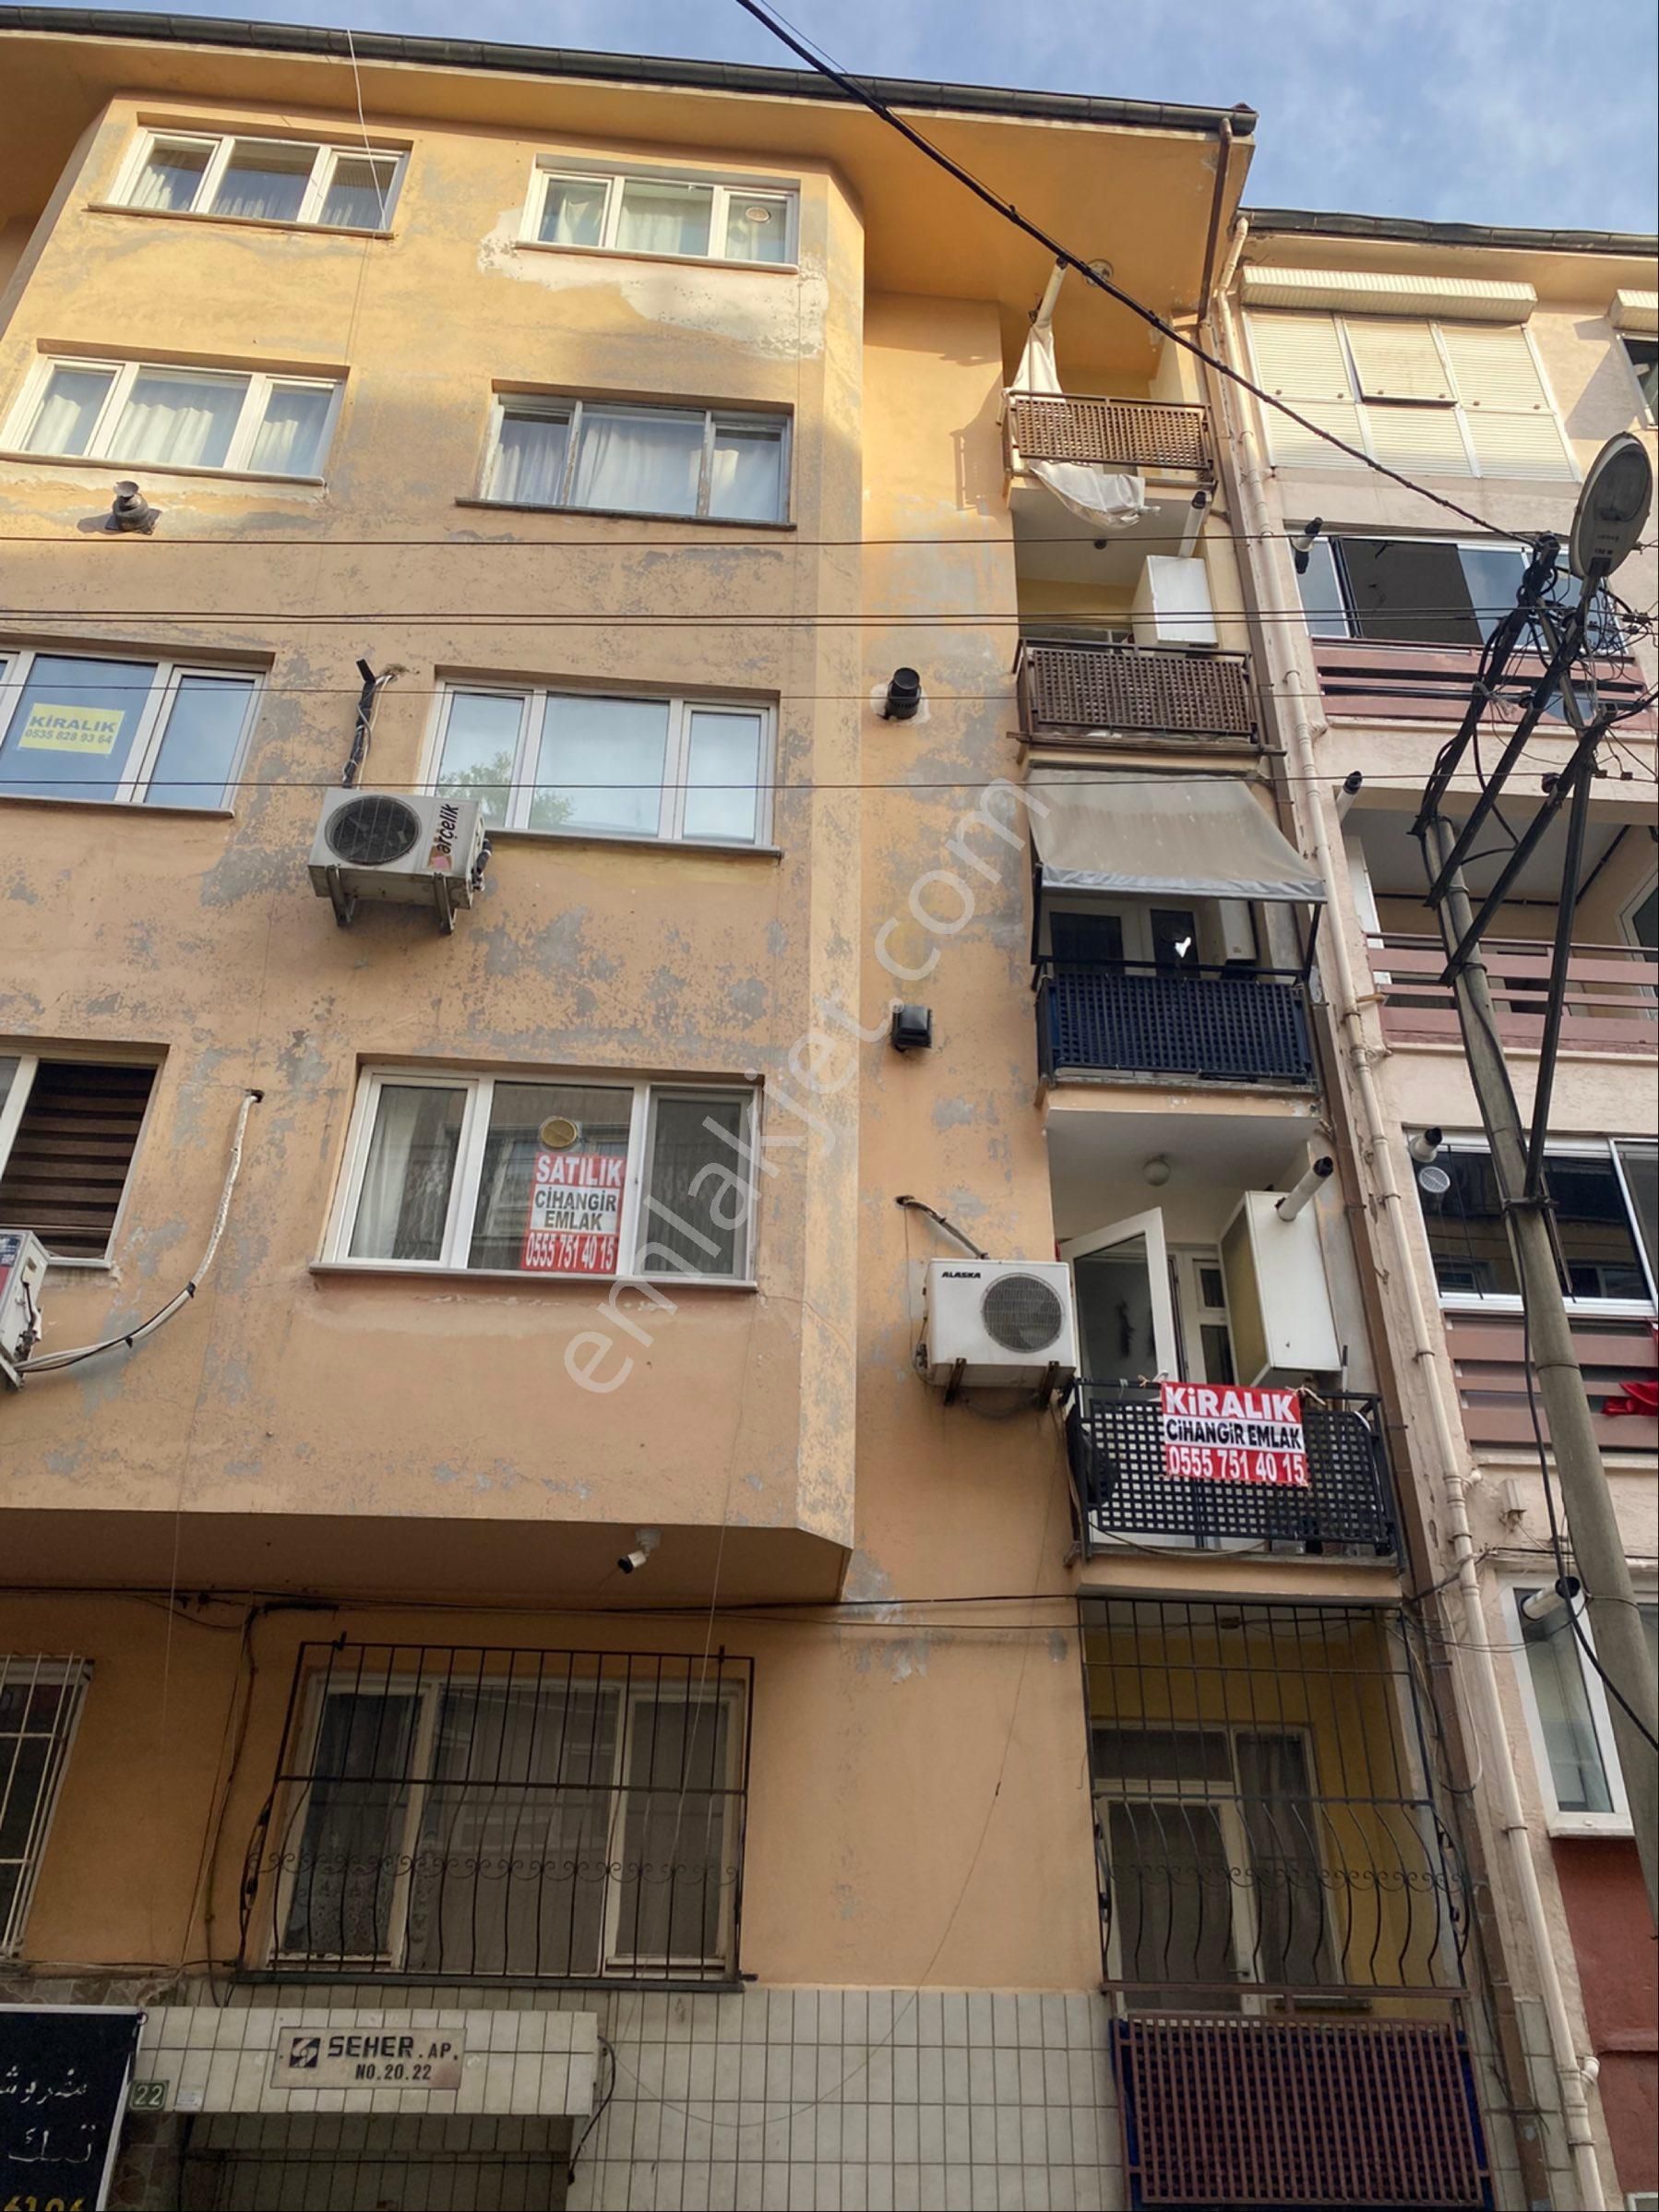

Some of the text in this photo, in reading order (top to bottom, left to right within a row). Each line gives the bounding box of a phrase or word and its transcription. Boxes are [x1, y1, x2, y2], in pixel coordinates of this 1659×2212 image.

[30, 715, 118, 733] KİRALIK
[436, 803, 460, 855] arçelik
[536, 1154, 623, 1187] SATILIK
[535, 1187, 616, 1212] CİHANGİR
[544, 1210, 603, 1231] EMLAK
[525, 1232, 615, 1271] 0555 751 40 15
[1248, 1425, 1301, 1450] EMLAK
[1169, 1446, 1305, 1482] 0555 751 40 15
[135, 2086, 162, 2105] 22
